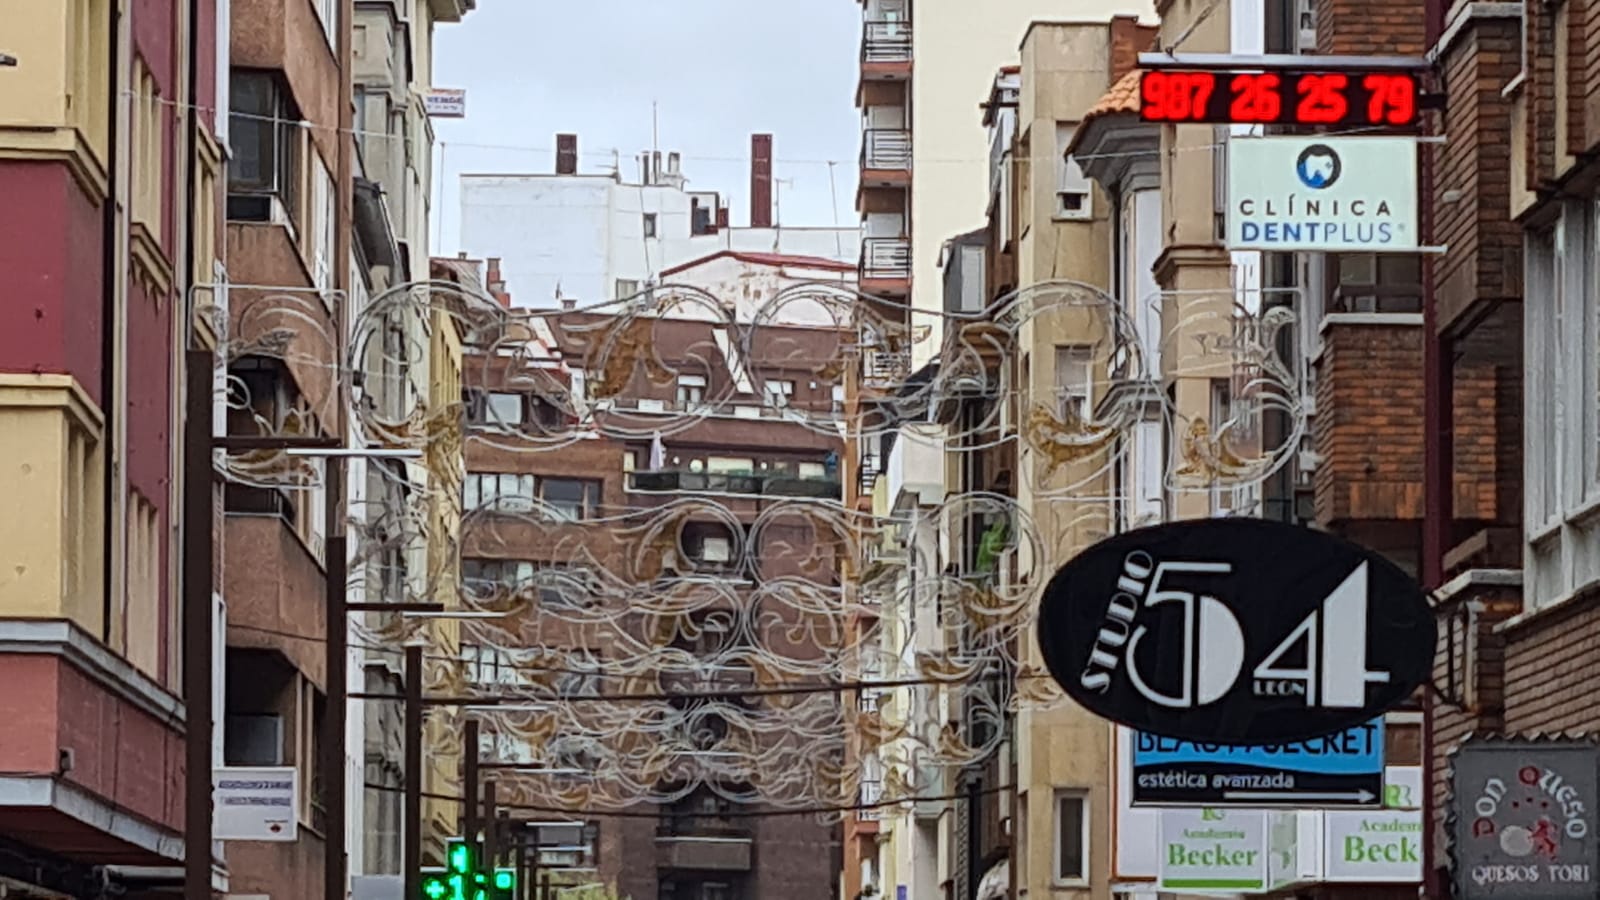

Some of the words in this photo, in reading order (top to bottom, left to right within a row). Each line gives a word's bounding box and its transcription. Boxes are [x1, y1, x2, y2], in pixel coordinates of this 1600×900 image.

[1142, 71, 1215, 120] 987
[1229, 73, 1281, 122] 26
[1295, 74, 1348, 123] 25
[1363, 75, 1414, 124] 79
[1239, 194, 1391, 216] CLÍNICA
[1081, 550, 1153, 695] STUDIO
[1126, 559, 1390, 708] 54
[1138, 769, 1207, 788] estética
[1212, 771, 1295, 788] avanzada
[1168, 843, 1258, 866] Becker
[1344, 835, 1419, 862] Beck
[1472, 864, 1540, 885] QUESOS
